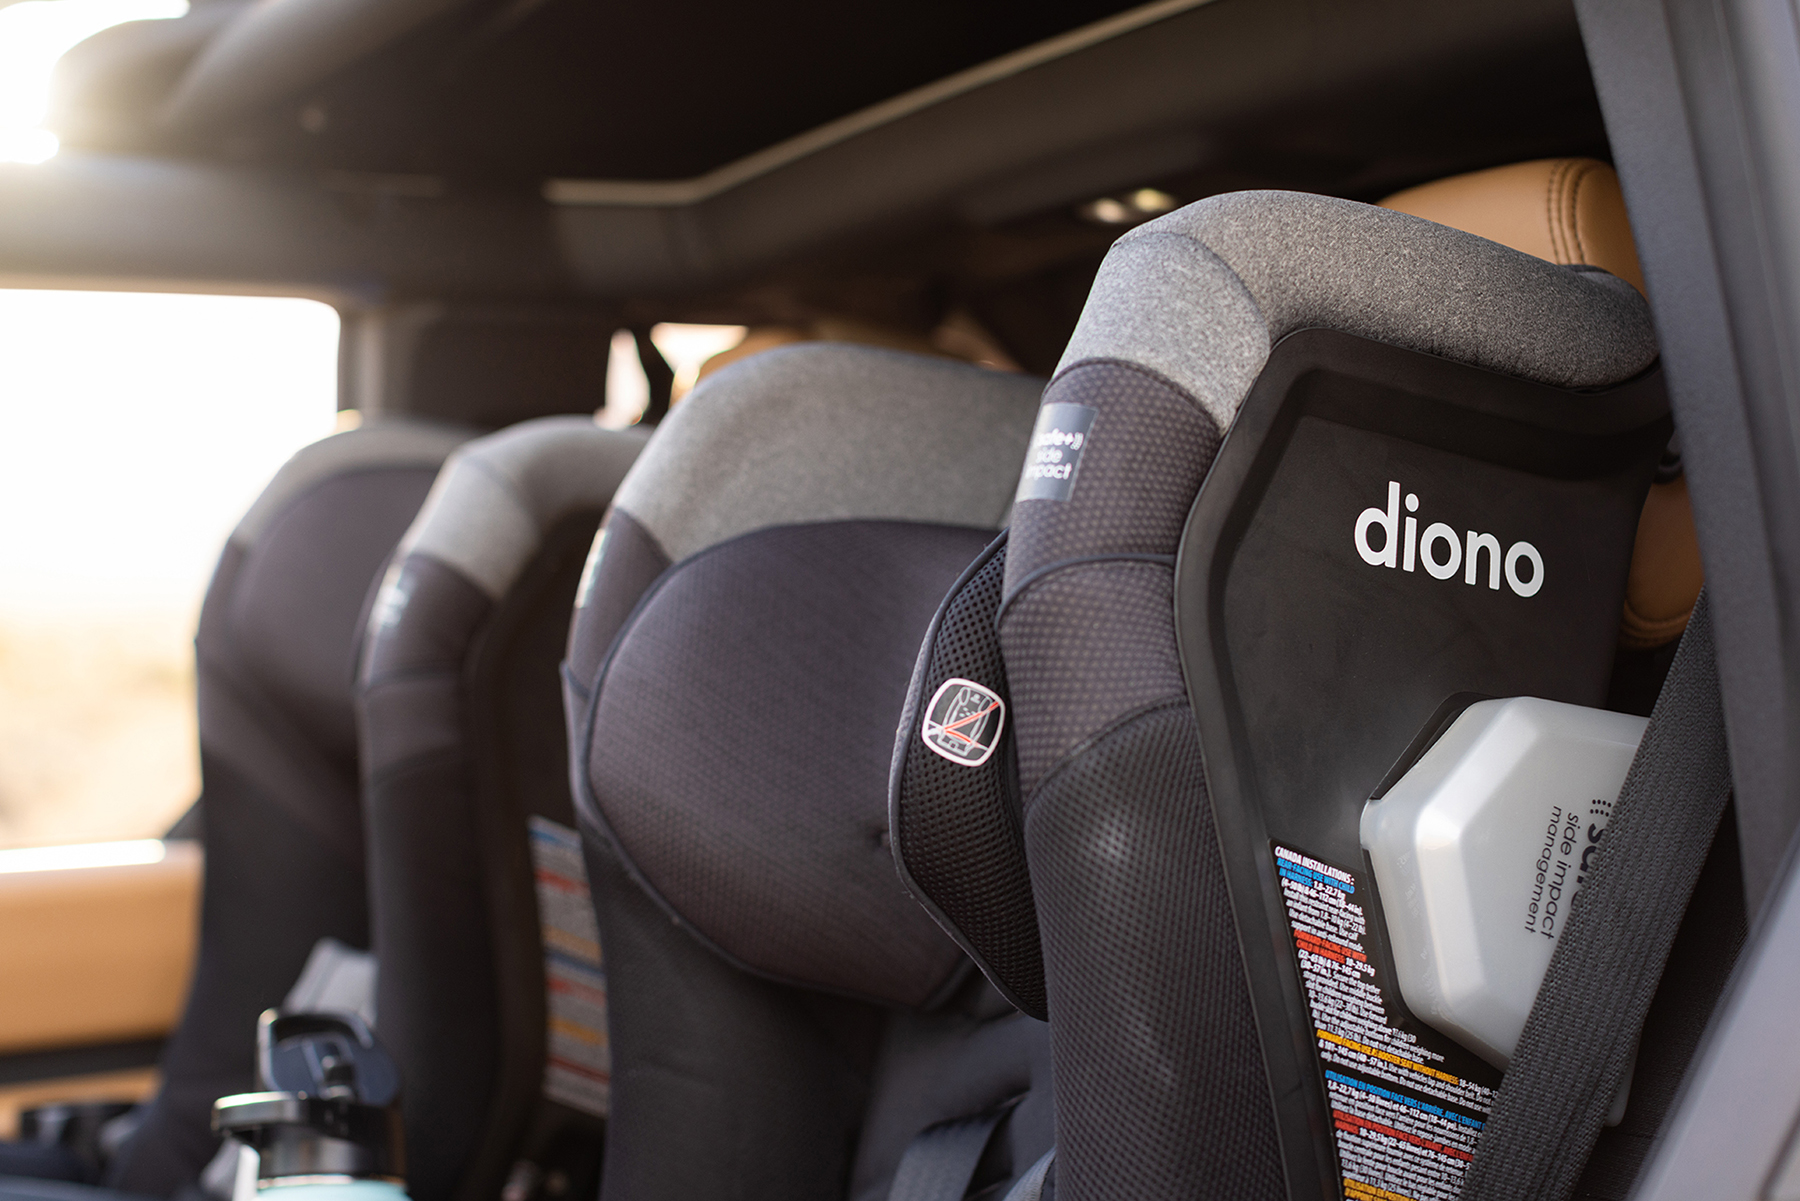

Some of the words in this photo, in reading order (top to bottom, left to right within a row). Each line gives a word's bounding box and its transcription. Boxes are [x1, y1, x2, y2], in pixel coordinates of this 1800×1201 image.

[1354, 481, 1545, 598] diono
[1275, 846, 1301, 864] CANADA
[1560, 812, 1581, 855] side
[1277, 858, 1312, 877] REAR-FACING
[1324, 876, 1338, 887] WITH
[1338, 882, 1354, 893] CHILD
[1524, 805, 1562, 933] management
[1541, 860, 1572, 939] impact
[1366, 1083, 1390, 1098] POSITION
